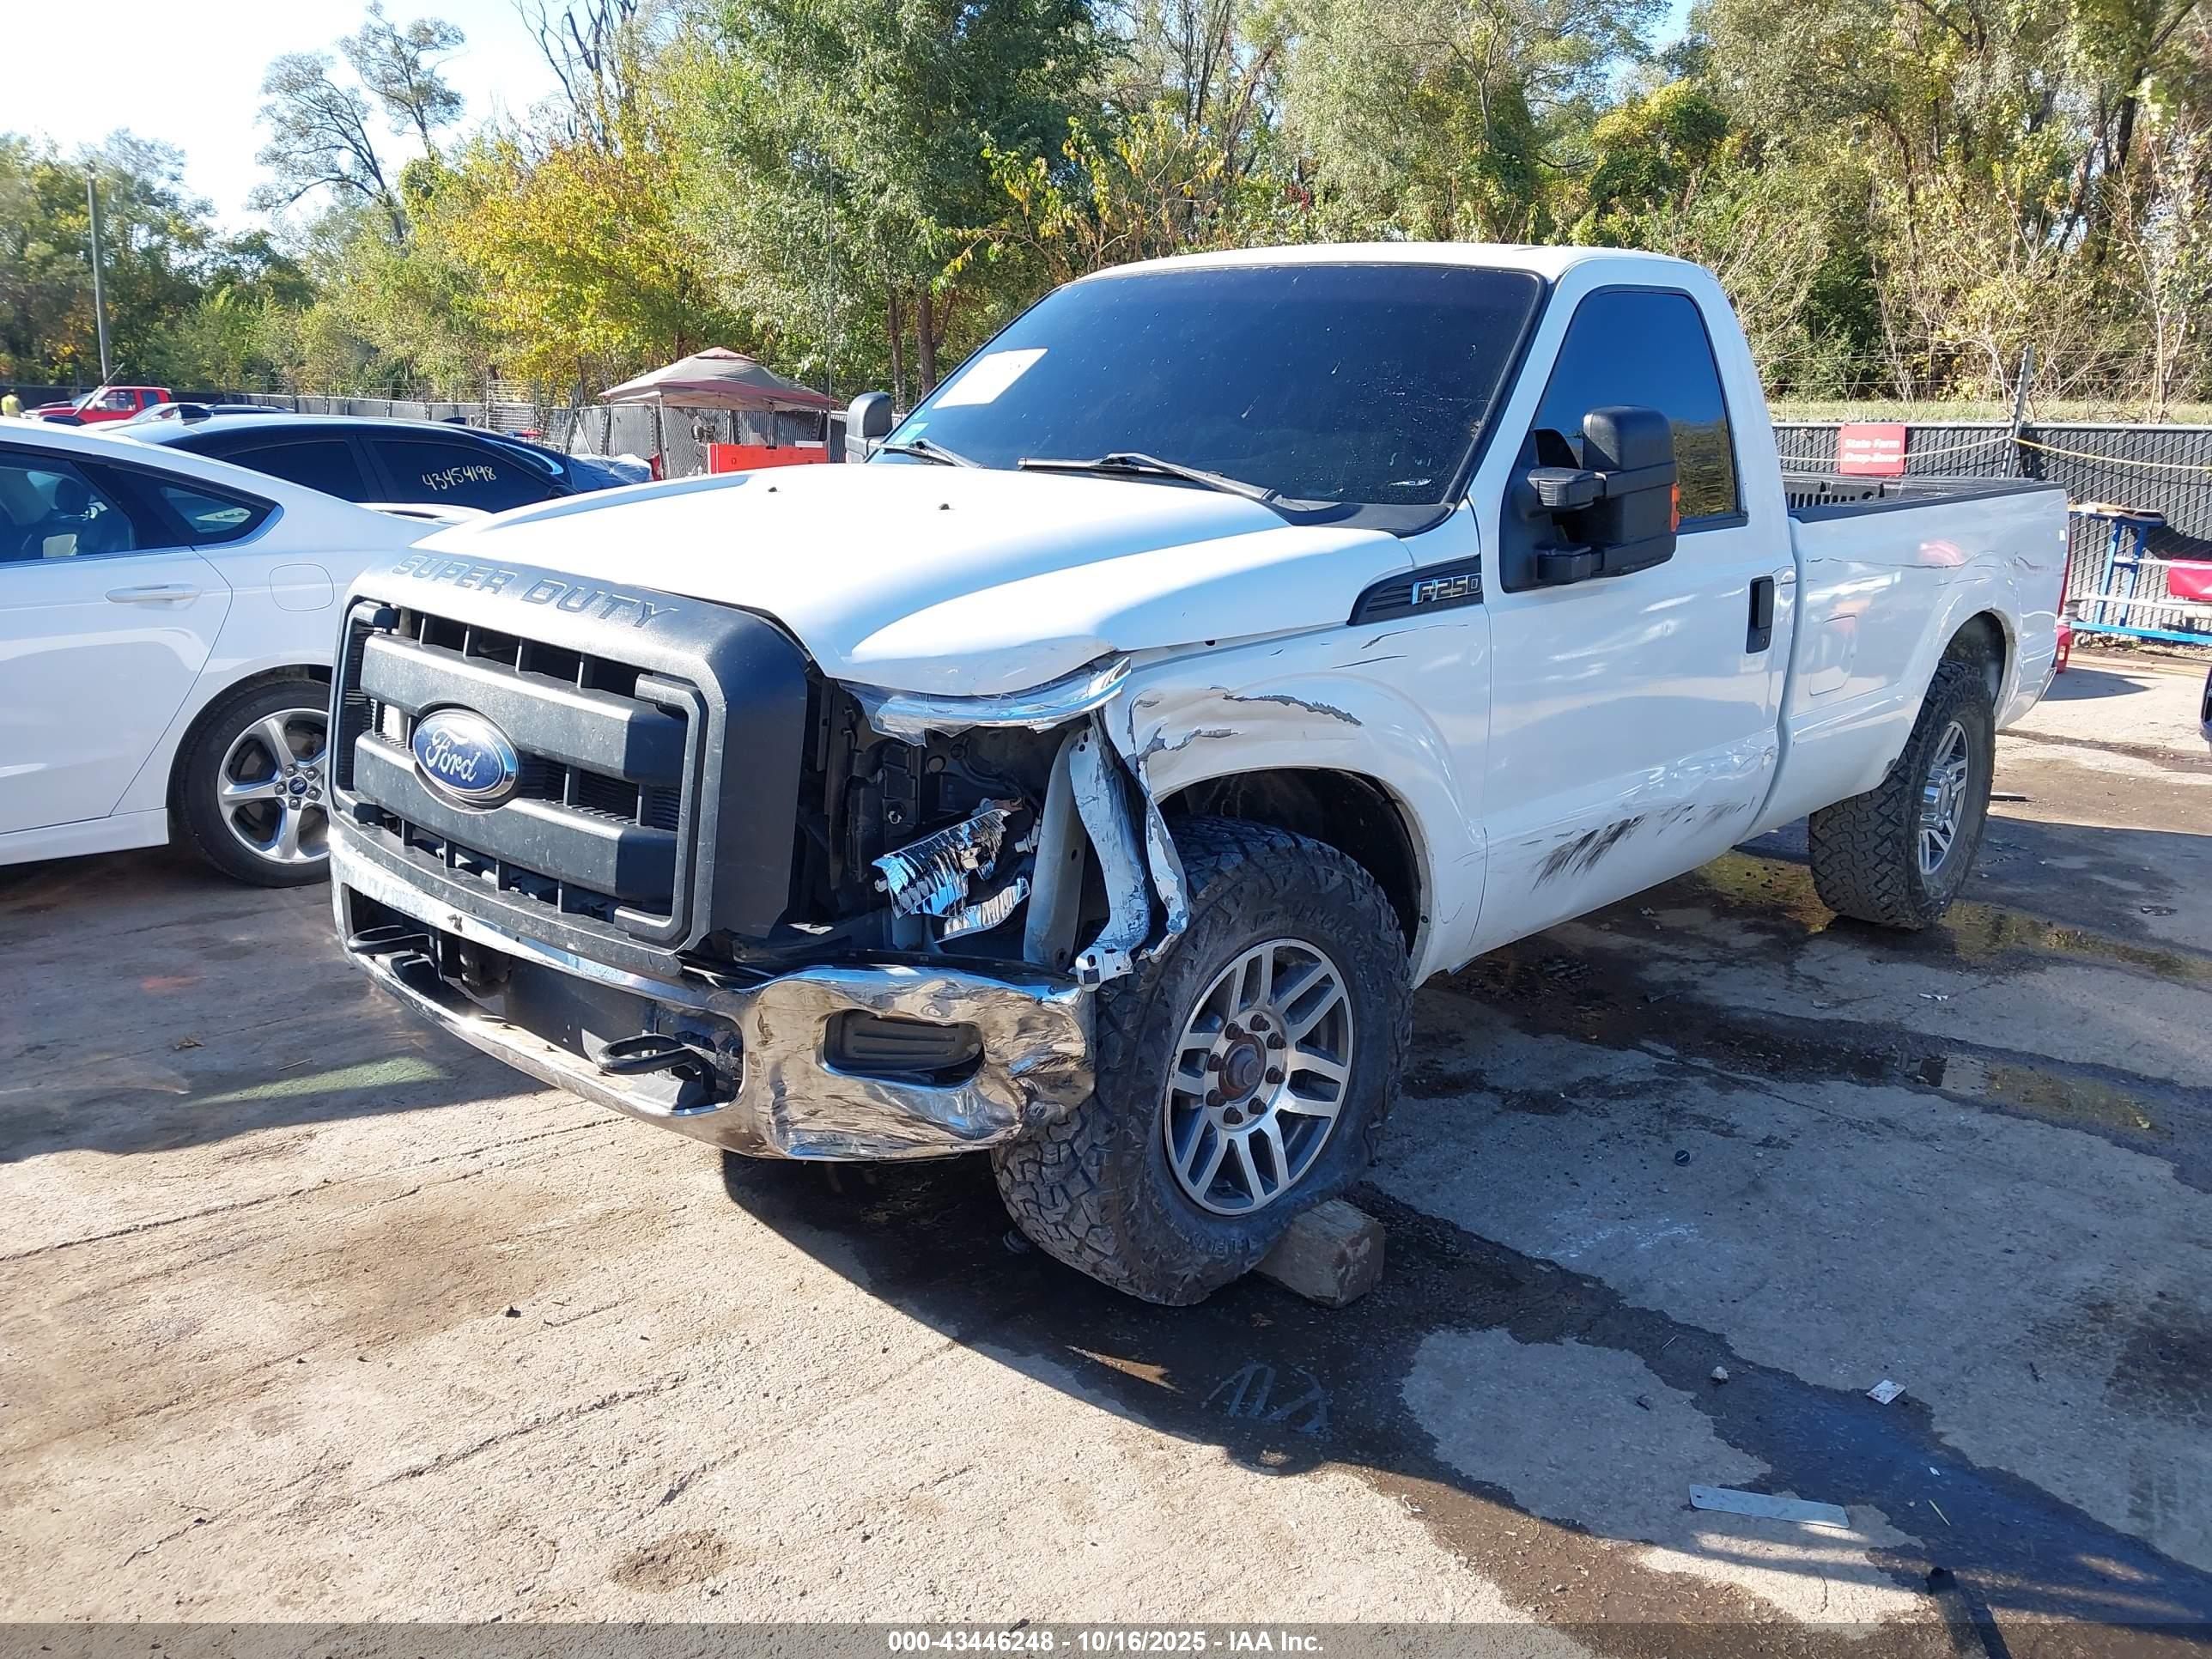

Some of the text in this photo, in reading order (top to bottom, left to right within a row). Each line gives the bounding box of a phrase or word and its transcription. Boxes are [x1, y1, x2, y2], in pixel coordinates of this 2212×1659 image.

[1844, 438, 1900, 449] State Farm
[422, 465, 497, 491] 43454198
[392, 555, 680, 629] SUPER DUTY
[425, 727, 482, 782] Ford
